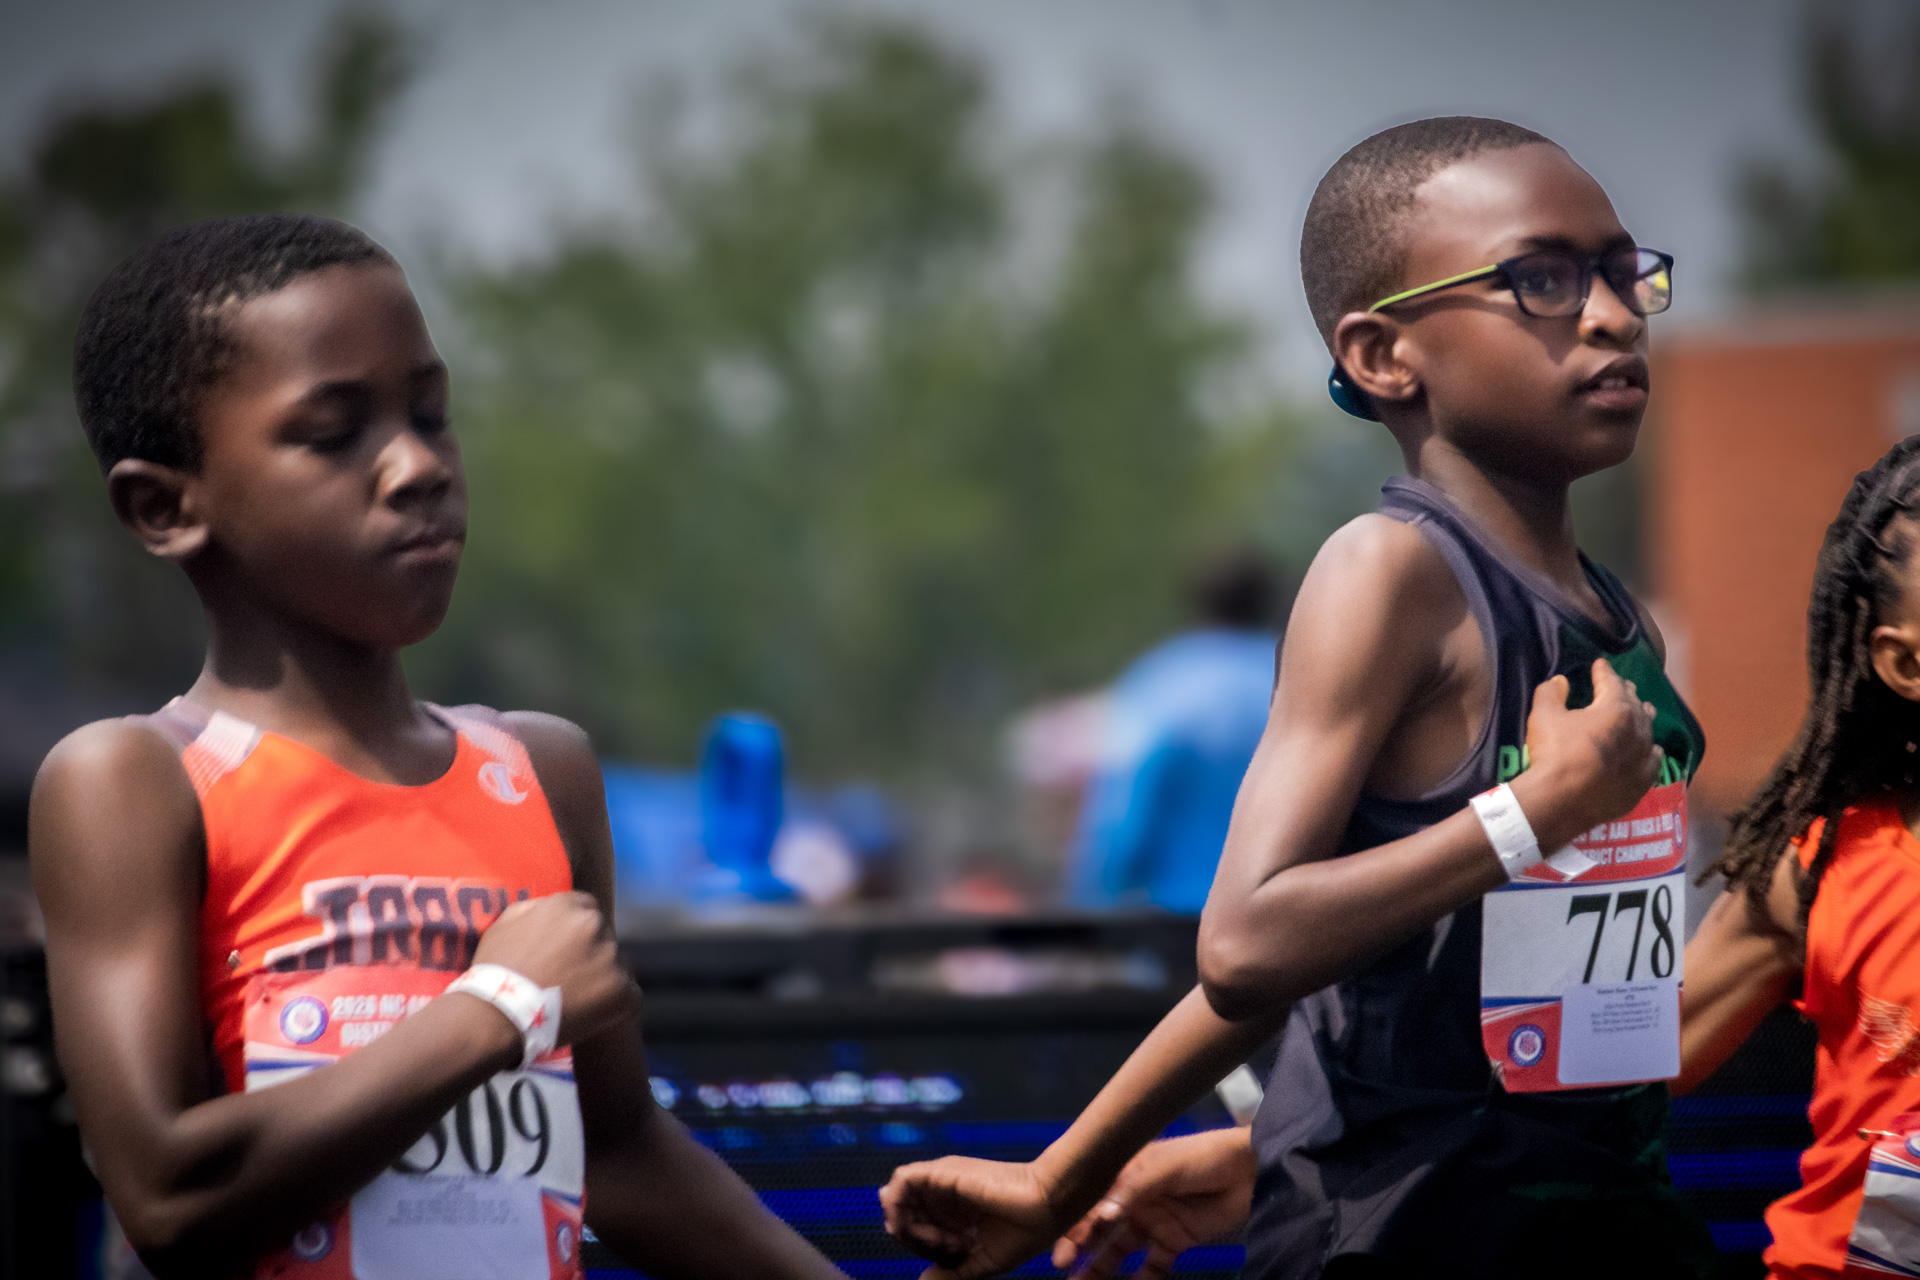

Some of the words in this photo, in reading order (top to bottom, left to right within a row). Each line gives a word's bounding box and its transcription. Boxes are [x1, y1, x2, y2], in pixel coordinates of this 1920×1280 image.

[1609, 821, 1629, 840] AAU
[300, 874, 531, 974] TRAC
[1565, 884, 1675, 984] 778
